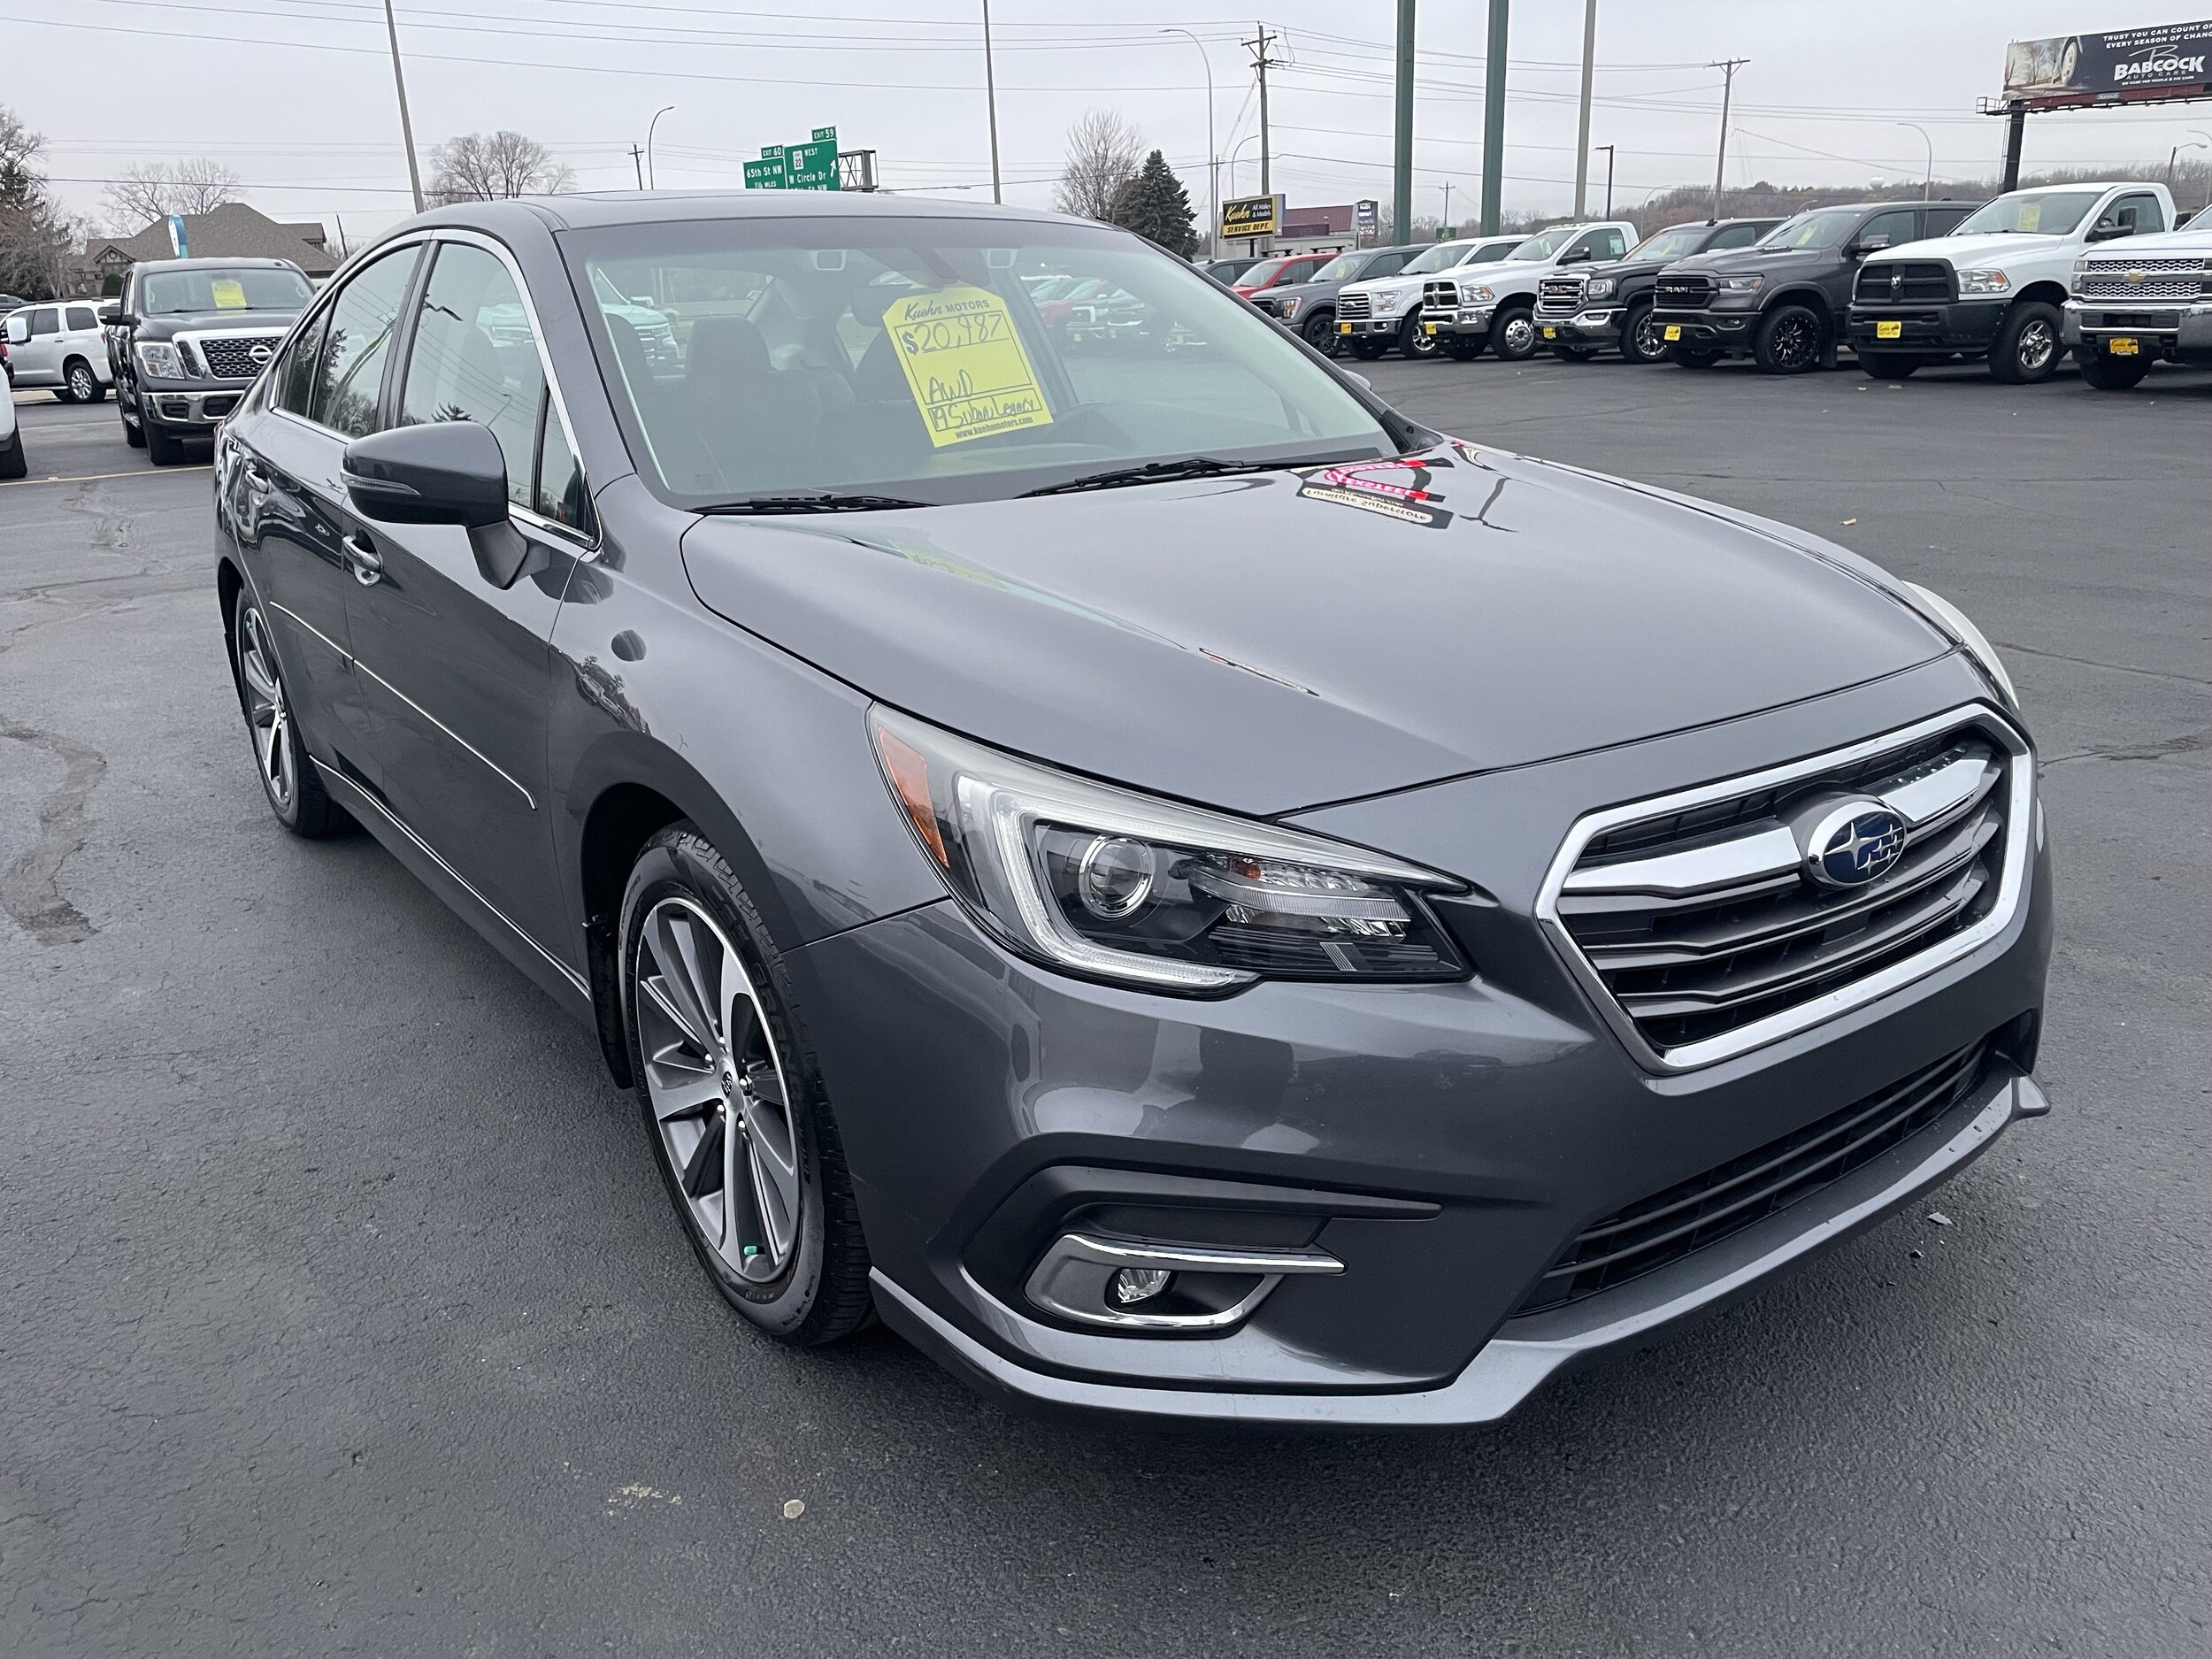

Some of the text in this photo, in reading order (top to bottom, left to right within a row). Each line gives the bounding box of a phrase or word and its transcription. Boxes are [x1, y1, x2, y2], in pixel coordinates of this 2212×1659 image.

[2106, 40, 2132, 49] EVERY
[2133, 36, 2168, 45] SEASON
[2183, 31, 2212, 40] CHANG
[2114, 56, 2206, 81] BABCOCK
[825, 129, 834, 138] 59
[773, 147, 782, 157] 60
[803, 148, 818, 157] WEST
[795, 158, 802, 167] 22
[747, 165, 782, 178] 65th St NW
[788, 171, 826, 184] W Circle Dr
[1225, 204, 1250, 222] Kuehn
[1227, 224, 1251, 234] SERVICE
[905, 299, 990, 321] Kuehn MOTORS
[928, 369, 973, 405] AWD
[955, 416, 1033, 439] www.kuehnmotors.com
